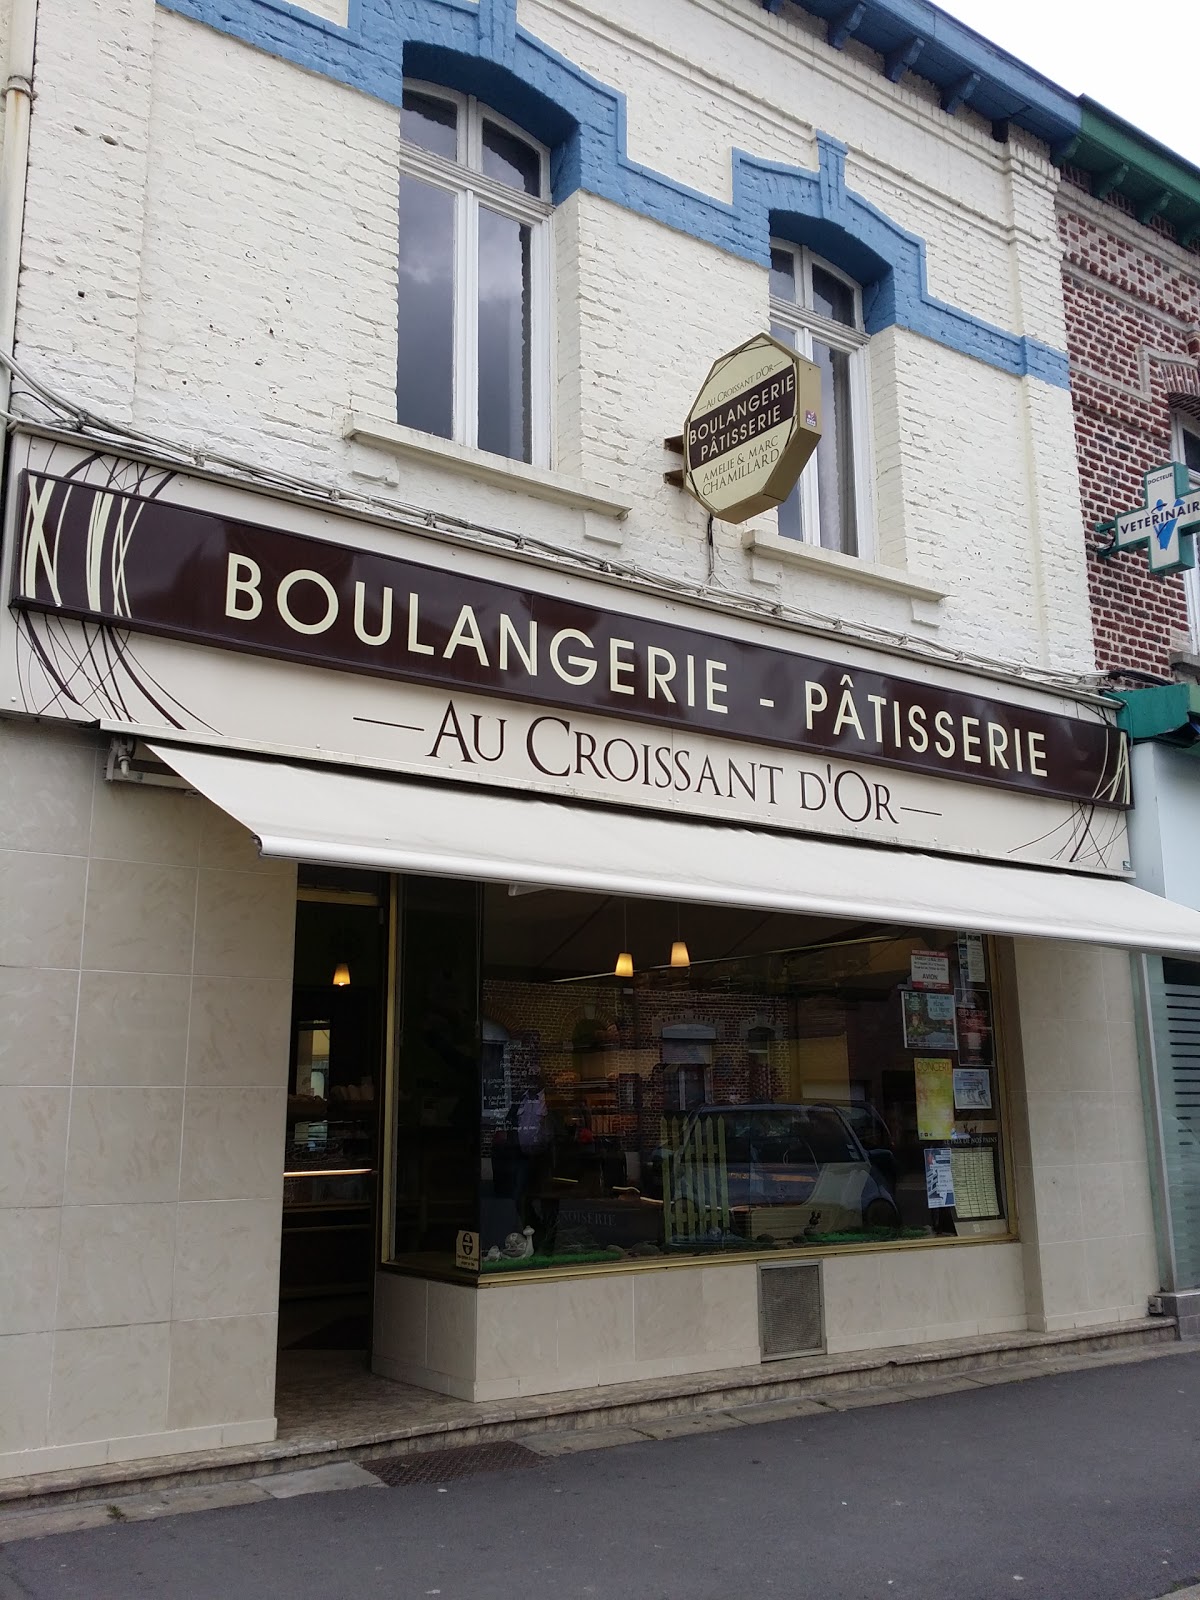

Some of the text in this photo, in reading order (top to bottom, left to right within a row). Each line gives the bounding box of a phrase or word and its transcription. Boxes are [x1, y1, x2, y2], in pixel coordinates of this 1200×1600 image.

[690, 374, 795, 446] BOULANGERIE
[706, 397, 716, 408] AU
[717, 375, 754, 403] CROISSANT
[701, 405, 781, 461] PÂTISSERIE
[702, 448, 780, 496] CHAMILLARD
[703, 435, 779, 482] AMELIE & MARC
[1147, 472, 1174, 486] DOCTEUR
[225, 552, 729, 715] BOULANGERIE
[805, 674, 1048, 778] PÂTISSERIE
[425, 700, 899, 824] AU CROISSANT D'OR
[917, 1061, 950, 1072] CONCERT
